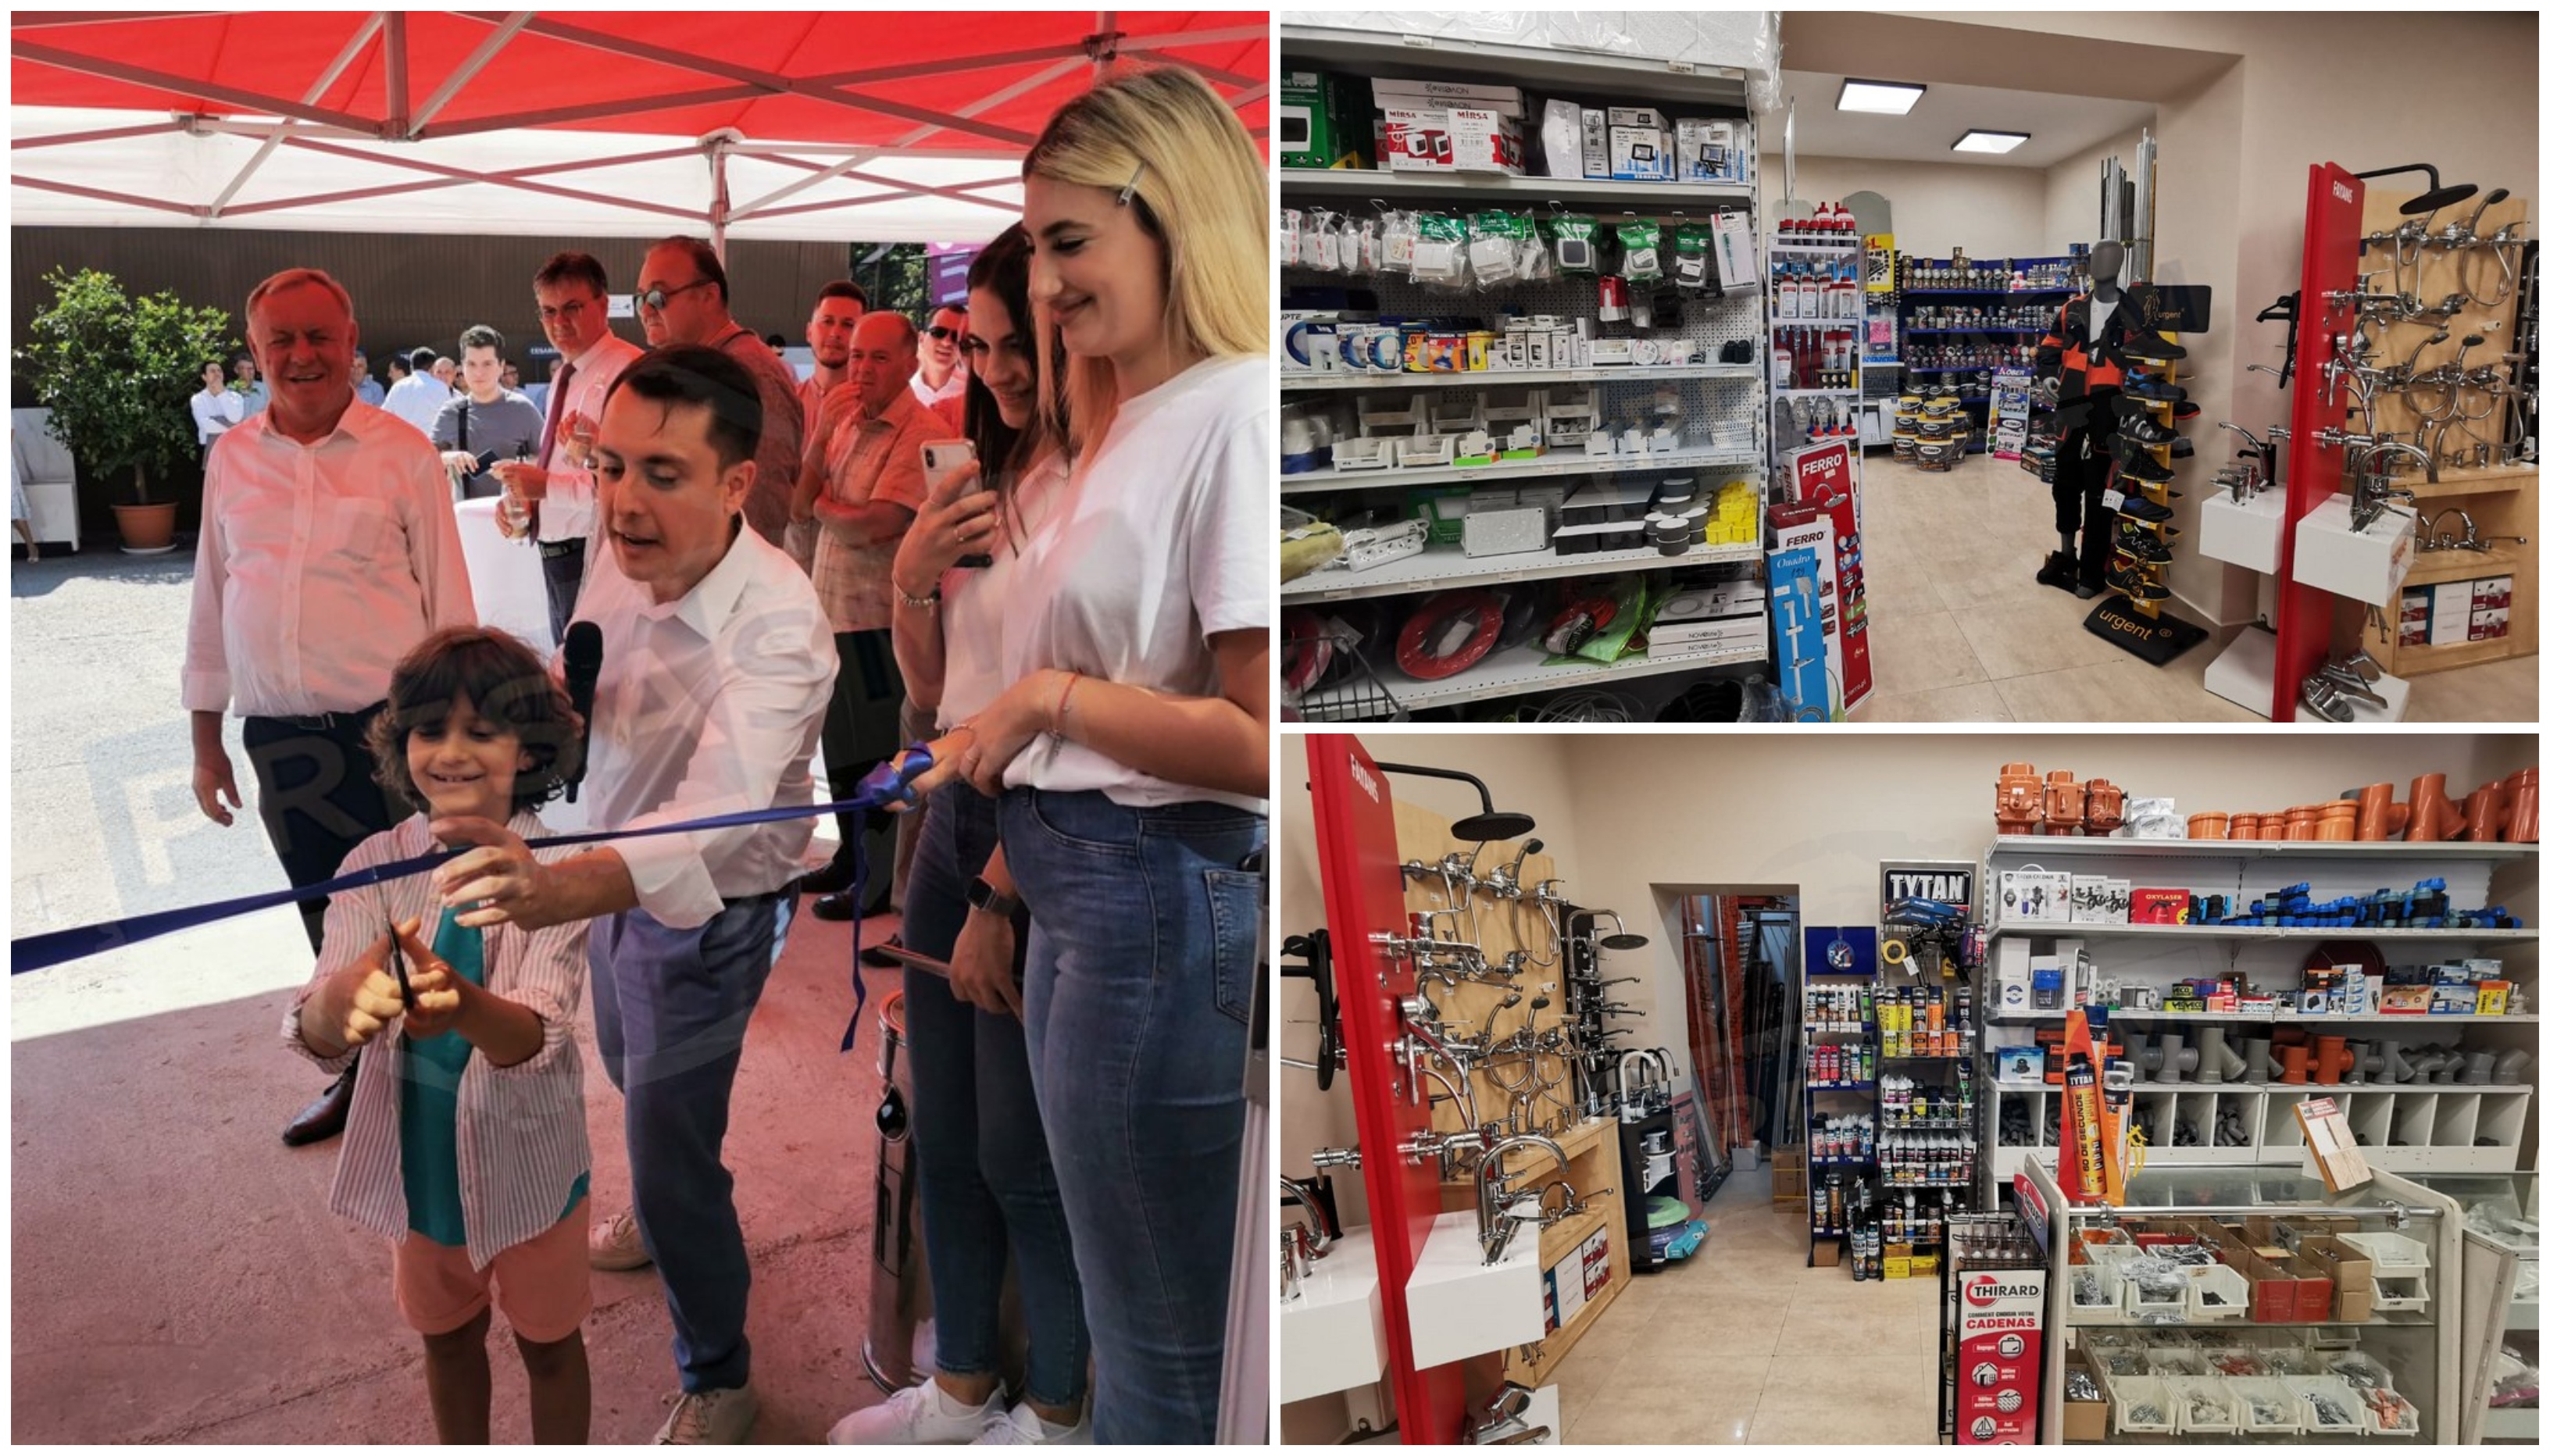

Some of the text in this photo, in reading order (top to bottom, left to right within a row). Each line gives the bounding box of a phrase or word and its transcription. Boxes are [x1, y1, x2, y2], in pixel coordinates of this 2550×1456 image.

[1801, 453, 1842, 477] FERRO
[1786, 531, 1824, 548] FERRO
[1777, 555, 1811, 569] Quadro
[2098, 608, 2153, 641] urgent
[1890, 874, 1964, 903] TYTAN
[2069, 1075, 2095, 1087] TYTAN
[2075, 1093, 2088, 1142] SECUNDE
[2081, 1144, 2089, 1157] DE
[1974, 1285, 2039, 1297] THIRARD
[1966, 1318, 2036, 1329] CADENAS
